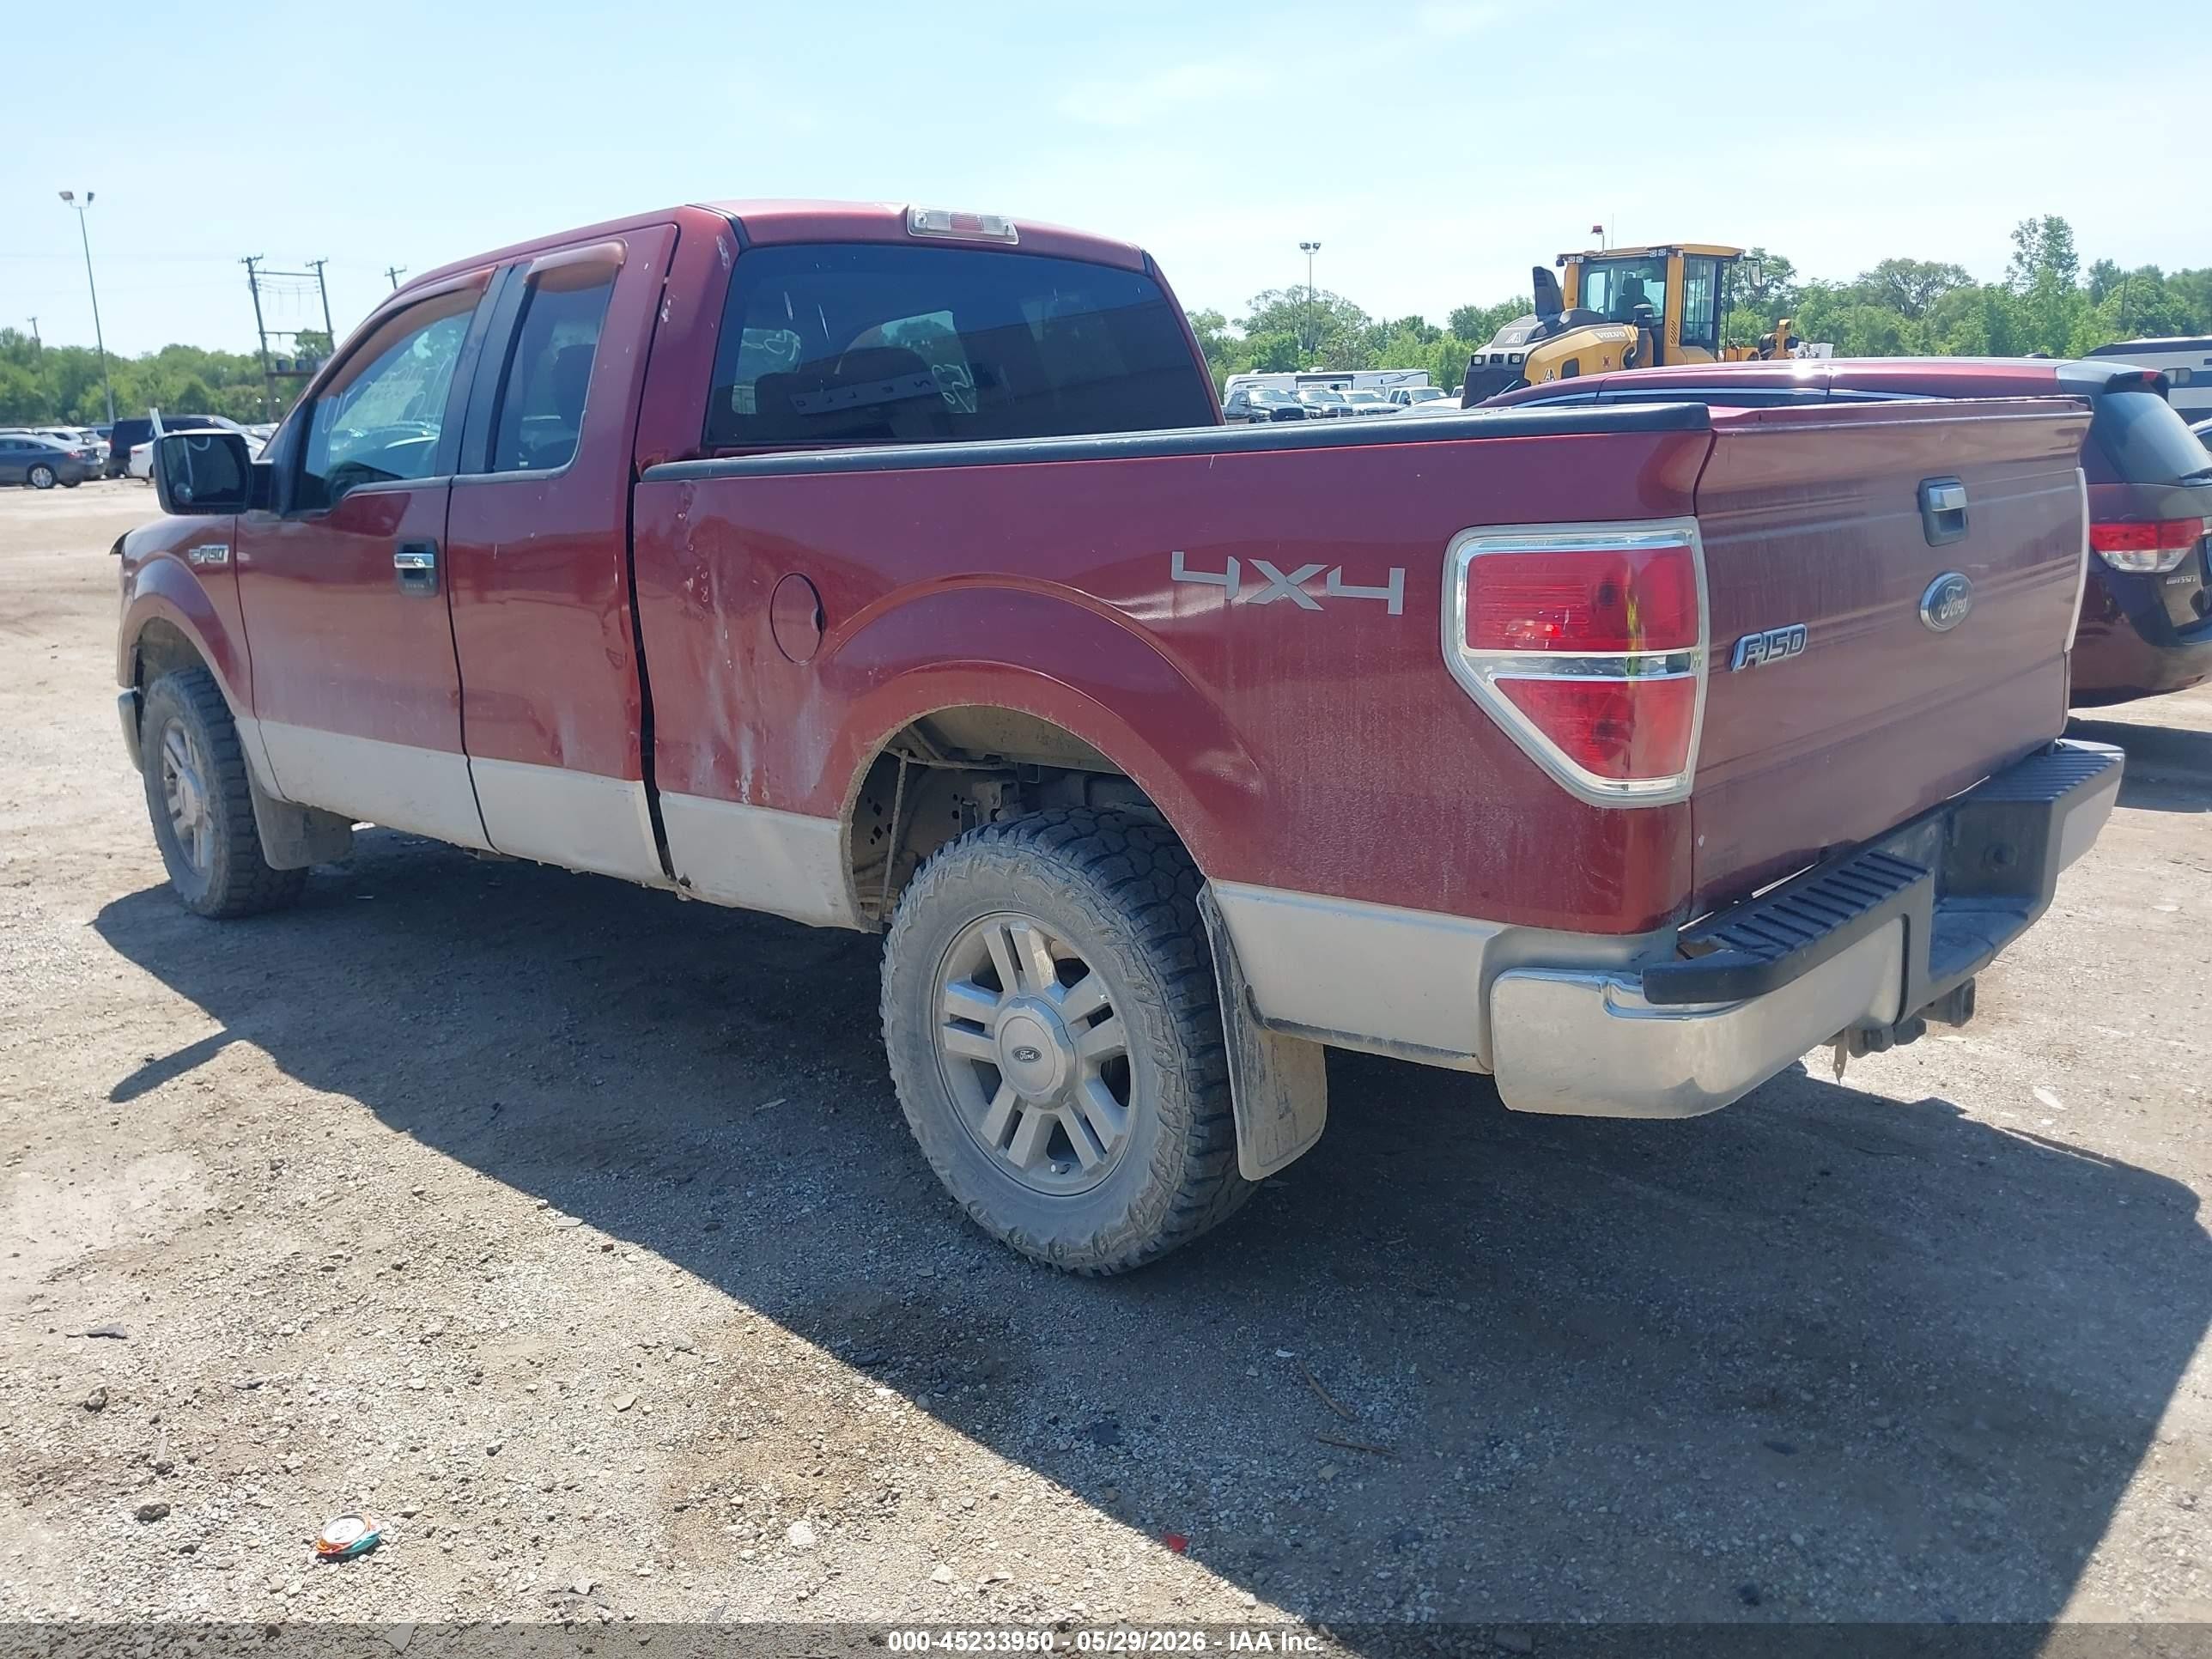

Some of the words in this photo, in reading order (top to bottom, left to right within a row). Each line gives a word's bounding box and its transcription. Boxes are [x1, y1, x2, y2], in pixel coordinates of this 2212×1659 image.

[1596, 330, 1626, 339] VOLVO
[1939, 584, 1968, 619] Ford
[1019, 1050, 1035, 1060] Ford
